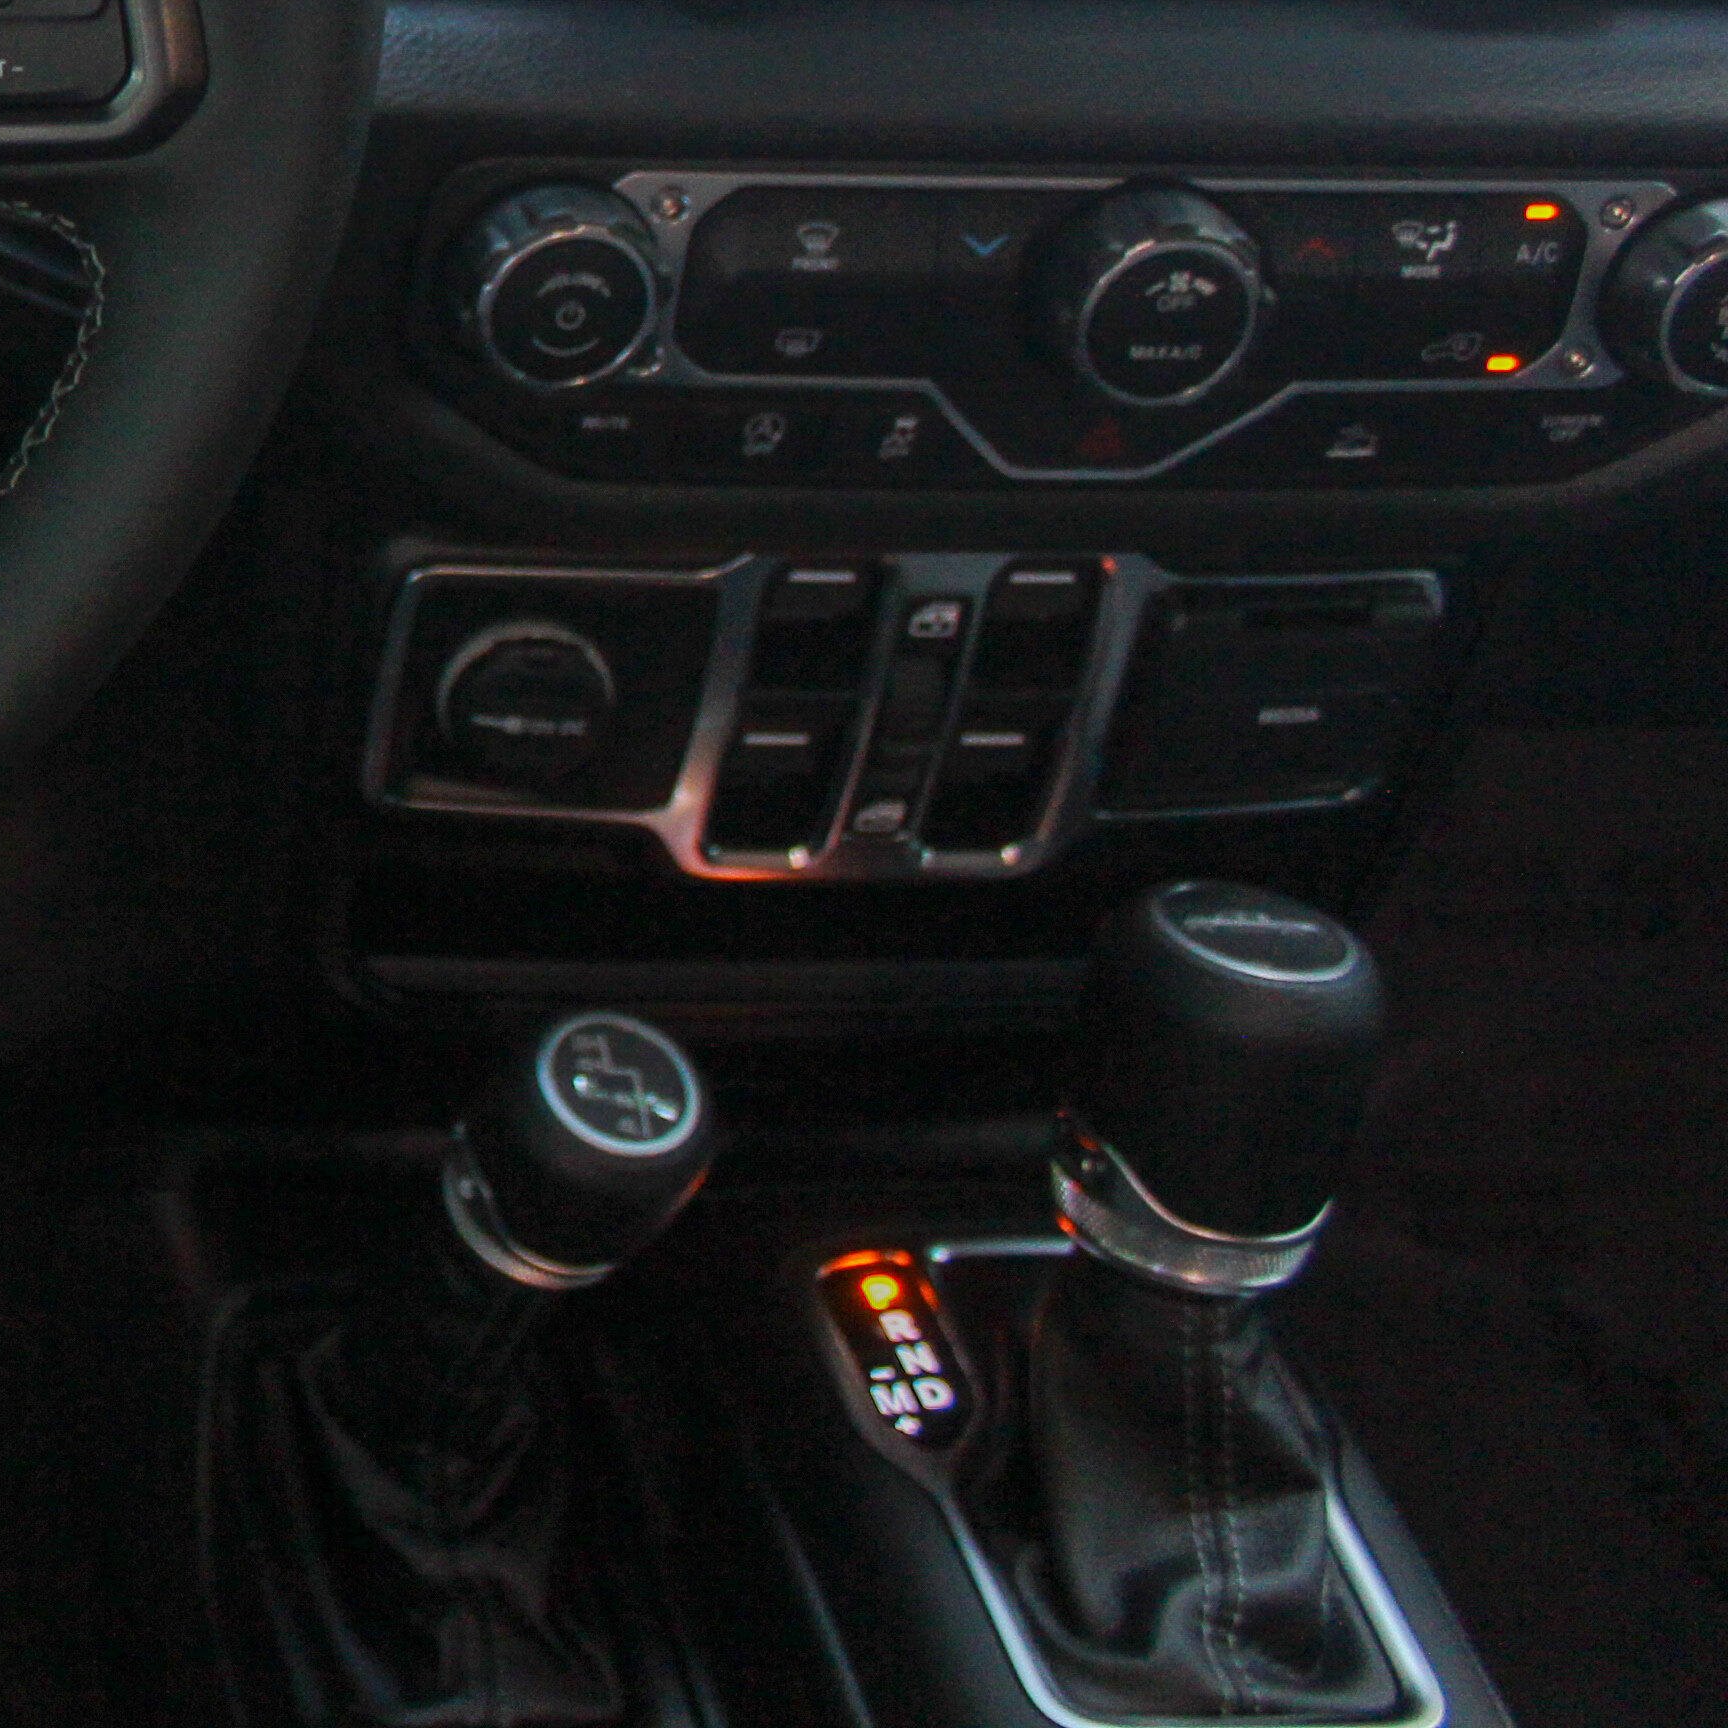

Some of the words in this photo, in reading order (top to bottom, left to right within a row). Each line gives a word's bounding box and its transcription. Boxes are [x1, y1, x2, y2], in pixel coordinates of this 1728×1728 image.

[1516, 239, 1561, 265] A/C
[878, 1309, 922, 1343] R
[895, 1341, 942, 1376] N
[869, 1379, 920, 1417] M
[912, 1376, 957, 1410] D
